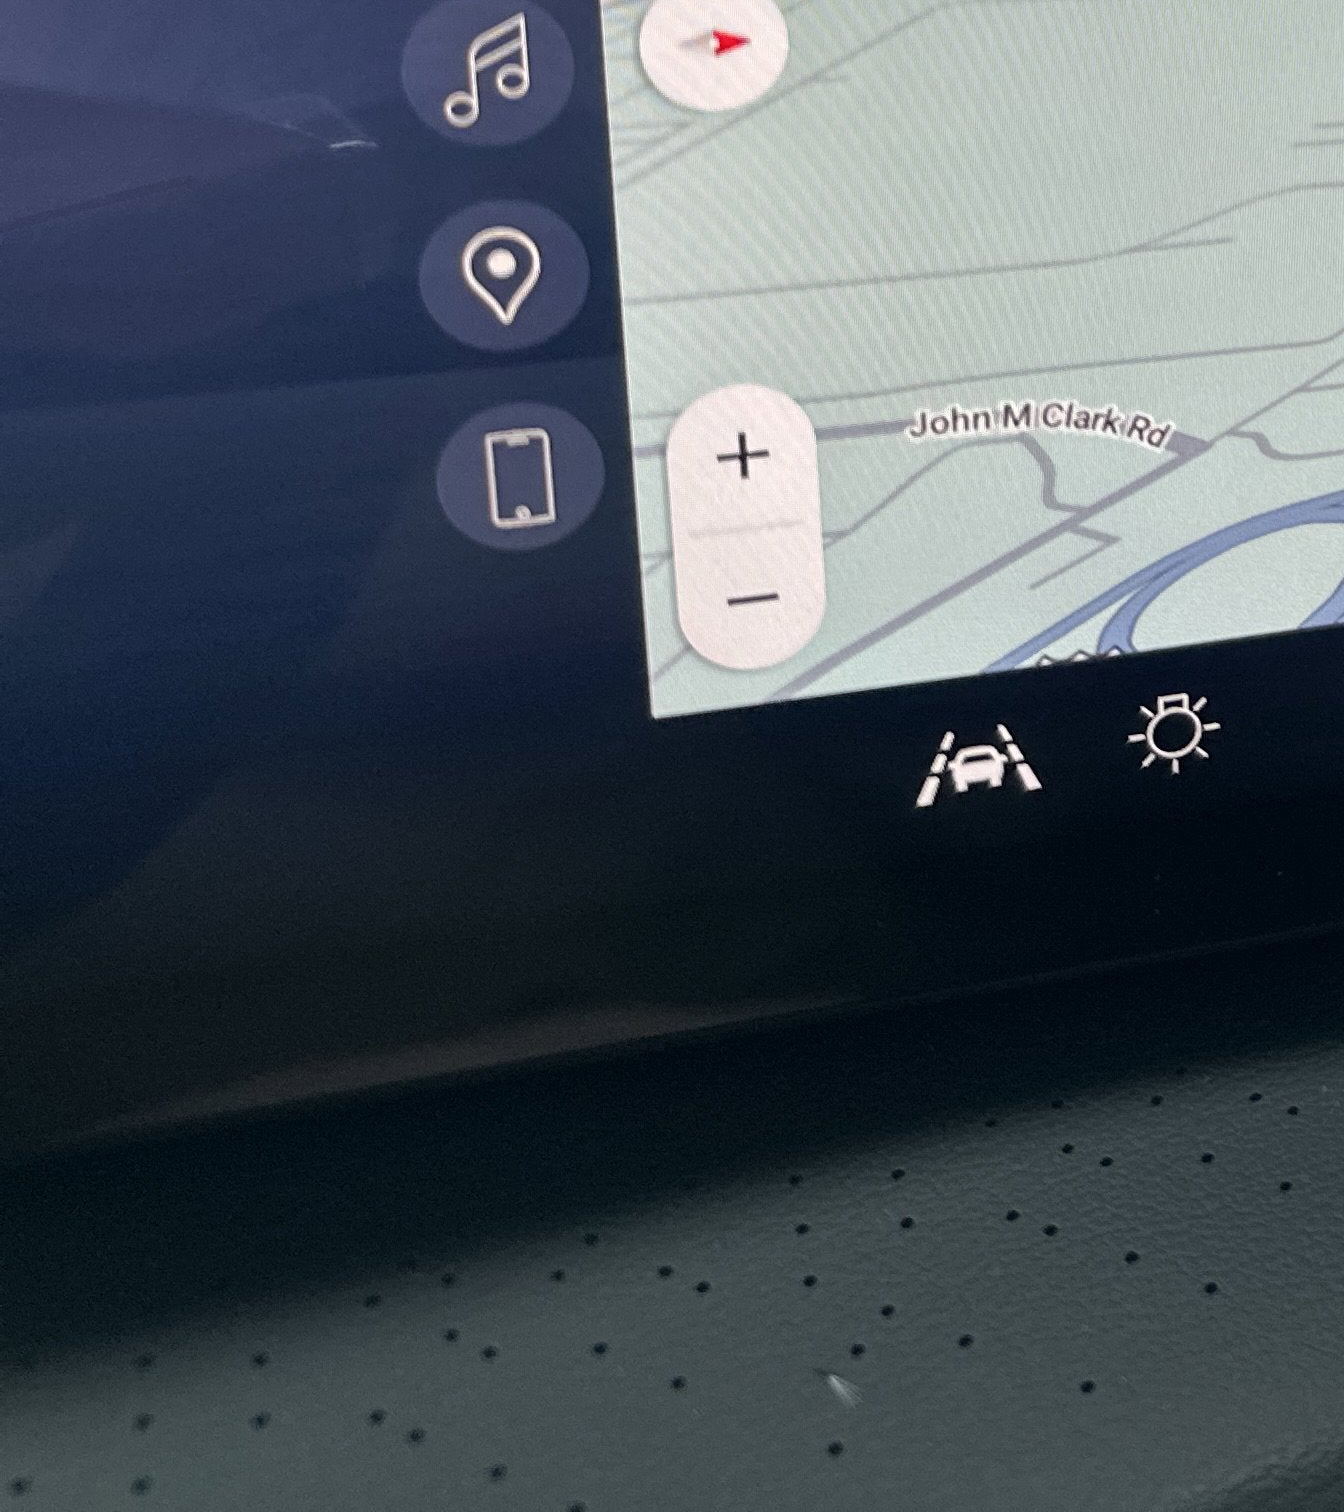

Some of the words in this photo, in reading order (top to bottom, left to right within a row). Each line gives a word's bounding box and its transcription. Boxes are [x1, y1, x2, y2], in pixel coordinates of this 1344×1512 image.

[909, 406, 991, 438] John
[1002, 402, 1032, 429] M
[1042, 401, 1122, 436] Clark
[1127, 413, 1171, 449] Rd
